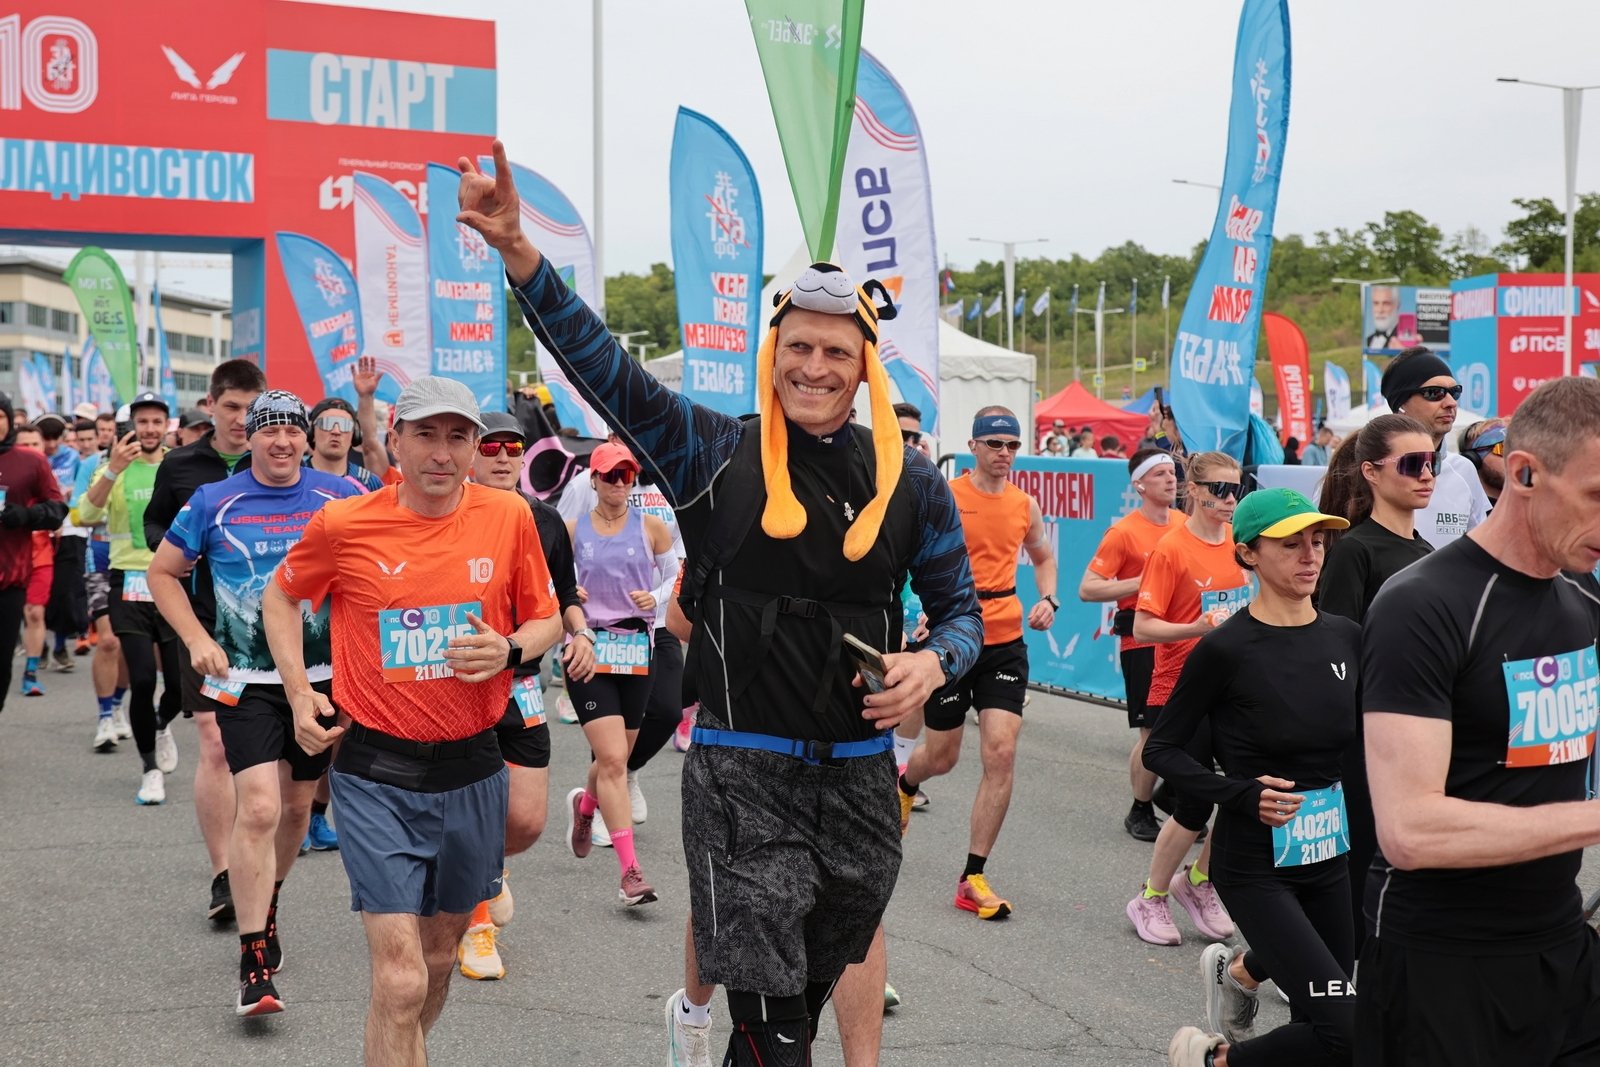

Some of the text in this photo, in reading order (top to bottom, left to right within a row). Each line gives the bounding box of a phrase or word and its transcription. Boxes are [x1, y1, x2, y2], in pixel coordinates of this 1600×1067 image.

[0, 14, 99, 113] 10
[310, 52, 455, 133] СТАРТ
[0, 139, 254, 203] ЛАДИВОСТОК
[643, 492, 667, 507] 2025
[1436, 513, 1459, 525] ДВБ
[467, 558, 494, 584] 10
[1218, 592, 1228, 601] D
[402, 609, 421, 628] C
[597, 643, 647, 665] 70506
[1536, 656, 1556, 683] C
[1516, 677, 1599, 742] 70055
[1292, 806, 1340, 842] 40276
[1301, 837, 1337, 865] 21.1KM
[1216, 954, 1226, 985] HOKA
